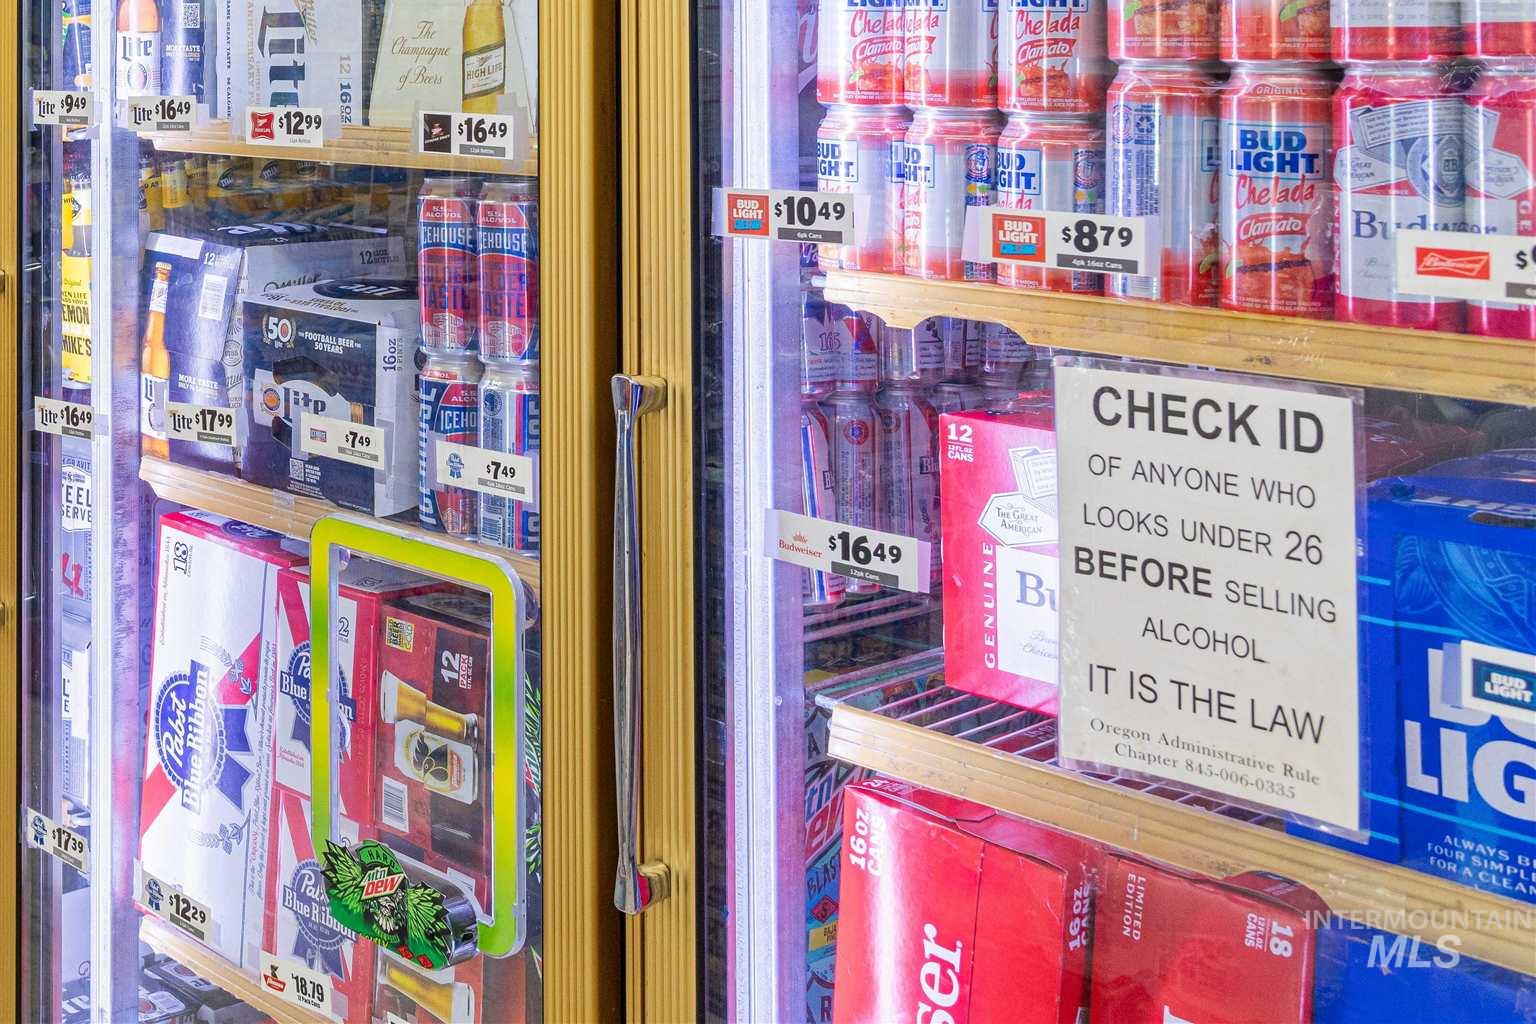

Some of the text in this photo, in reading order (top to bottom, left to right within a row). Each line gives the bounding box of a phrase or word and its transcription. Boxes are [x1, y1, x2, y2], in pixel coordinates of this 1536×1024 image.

[416, 20, 438, 40] The
[1015, 8, 1081, 38] Chelada
[121, 35, 153, 62] Lite
[391, 40, 450, 70] Champagne
[412, 69, 443, 86] Beers
[38, 94, 86, 117] Lite $949
[133, 99, 190, 125] Lite $1649
[278, 112, 321, 135] $1299
[458, 118, 507, 143] $1649
[1239, 129, 1307, 152] BUD
[1230, 152, 1320, 175] LIGHT
[1236, 175, 1315, 207] Chelada
[732, 207, 765, 220] LIGHT
[736, 198, 759, 211] BUD
[774, 195, 846, 227] $1049
[998, 228, 1040, 244] LIGHT
[1003, 220, 1031, 235] BUD
[1061, 219, 1134, 253] $879
[1239, 215, 1302, 241] Clamato
[359, 250, 373, 265] 12
[305, 331, 354, 348] FOOTBALL BEER
[323, 343, 343, 355] YEARS
[40, 406, 92, 427] Lite $1649
[171, 409, 232, 432] Lite $1799
[1092, 385, 1324, 454] CHECK ID
[345, 432, 370, 448] $749
[947, 424, 973, 442] 12
[486, 461, 515, 479] $749
[947, 451, 974, 463] CANS
[1088, 454, 1316, 509] OF ANYONE WHO
[1000, 519, 1043, 535] AMERICAN
[1083, 503, 1323, 566] LOOKS UNDER 26
[173, 541, 188, 576] 18
[778, 539, 823, 559] Budweiser
[828, 531, 902, 565] $1649
[1074, 546, 1337, 623] BEFORE SELLING
[982, 543, 996, 669] GENUINE
[1142, 617, 1269, 664] ALCOHOL
[440, 649, 461, 684] 12
[458, 654, 473, 690] PACK
[1483, 681, 1533, 704] LIGHT
[1491, 671, 1528, 693] BUD
[1088, 664, 1324, 744] IT IS THE LAW
[161, 693, 188, 769] Pabst
[1090, 717, 1320, 786] Oregon Administrative Rule
[1114, 743, 1296, 800] Chapter 845-006-0335
[52, 827, 84, 853] $1739
[1427, 842, 1465, 861] FOUR
[1444, 835, 1509, 861] ALWAYS
[1430, 857, 1472, 877] FOR A
[168, 895, 206, 924] $1229
[1122, 873, 1137, 937] EDITION
[1130, 875, 1147, 942] LIMITED
[1269, 920, 1292, 958] 18
